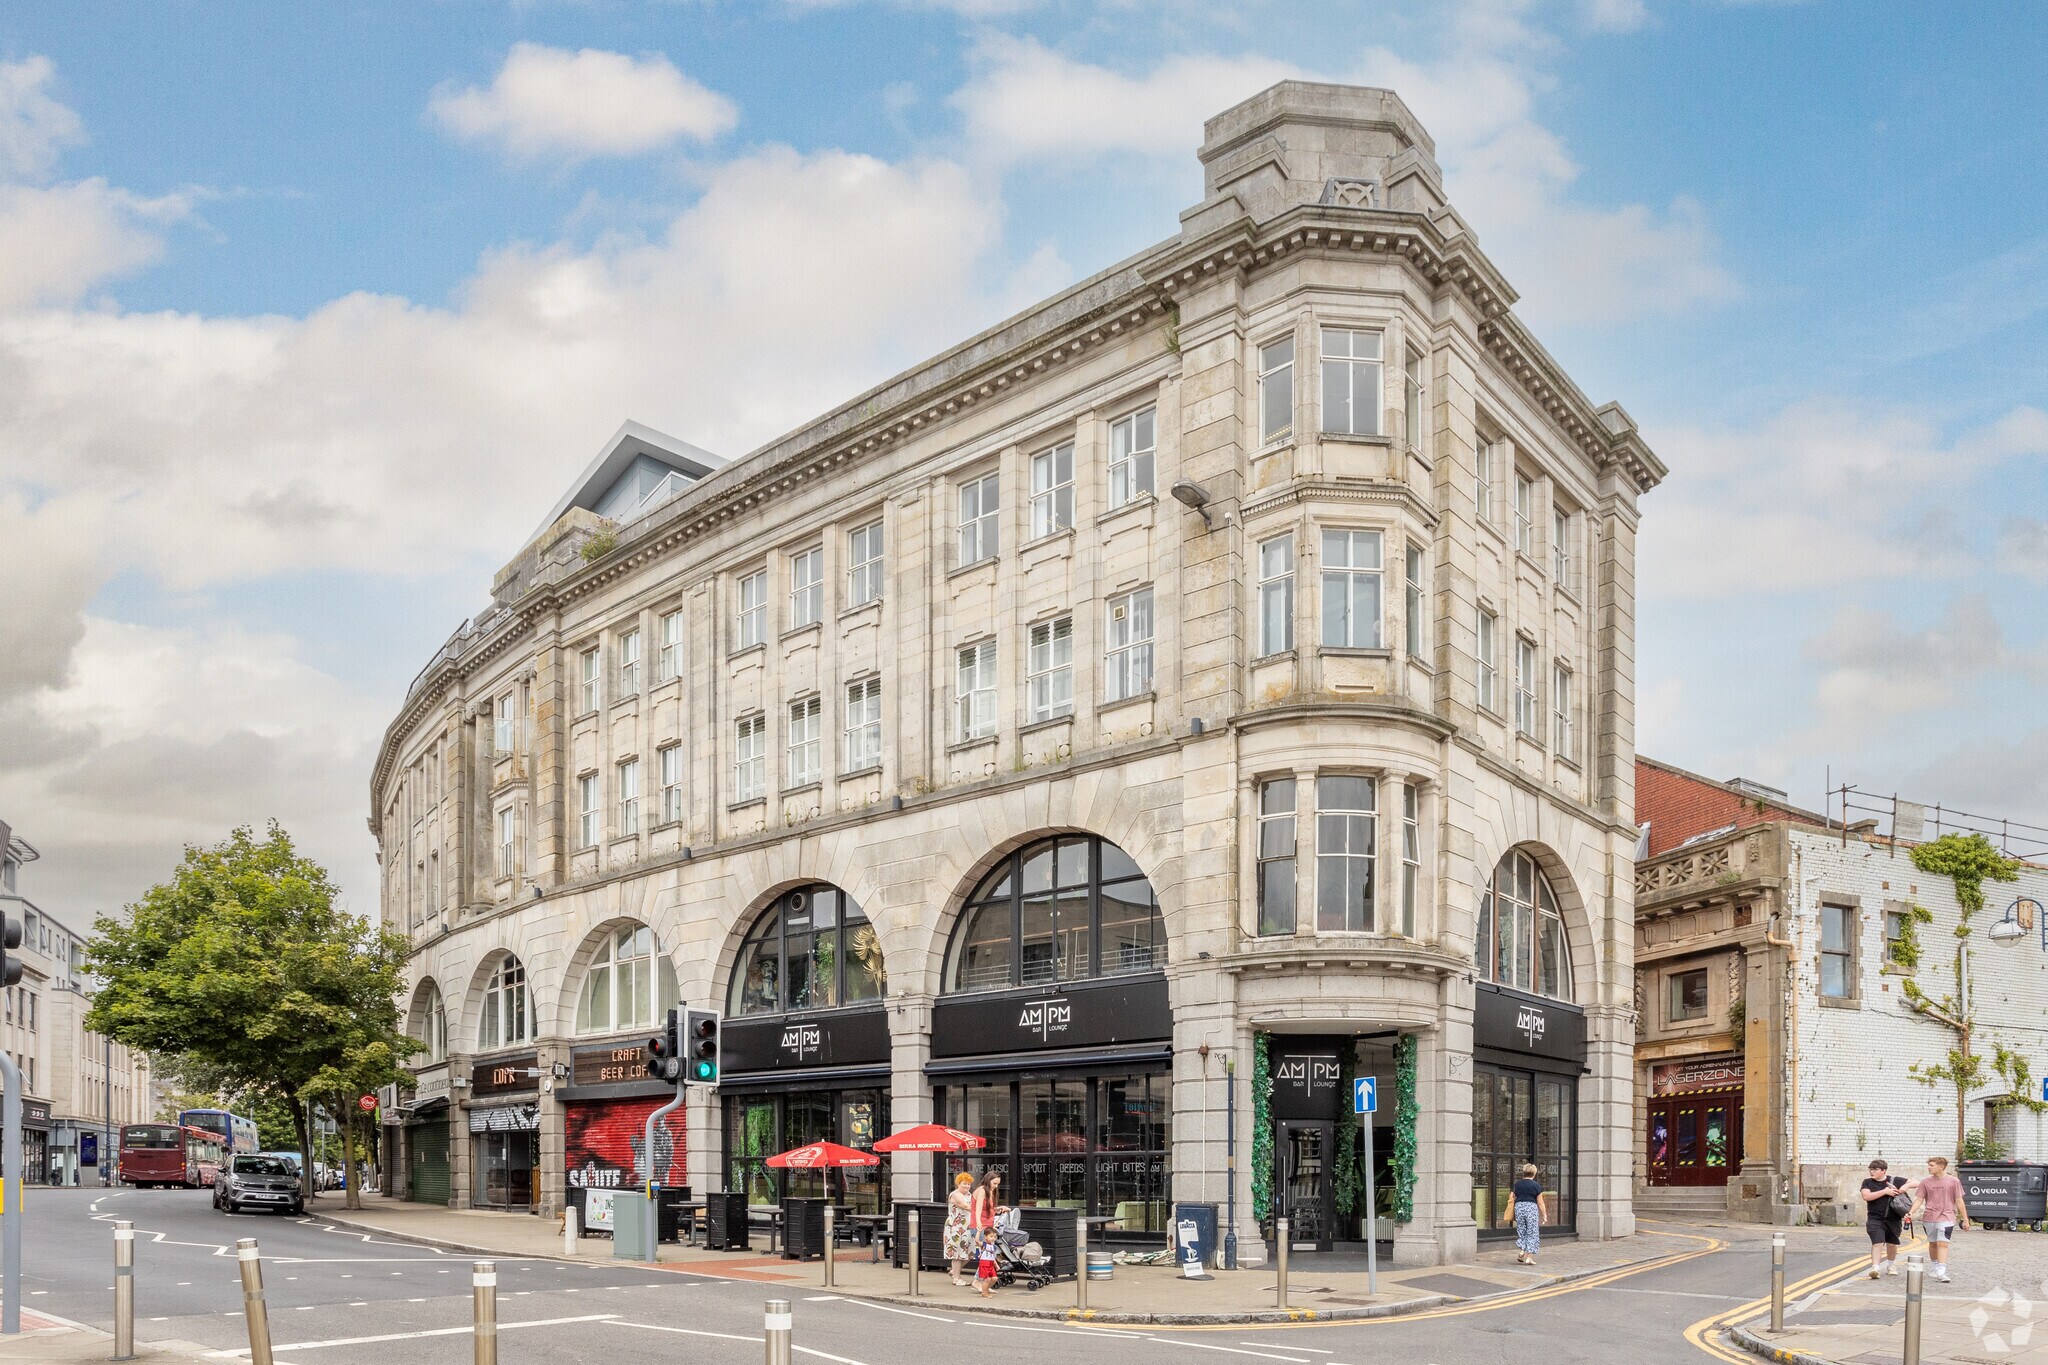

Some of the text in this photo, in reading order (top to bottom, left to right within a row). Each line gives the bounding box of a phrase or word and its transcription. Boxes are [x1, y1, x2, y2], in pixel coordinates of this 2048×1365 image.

[611, 1048, 642, 1062] CRAFT
[1699, 1061, 1731, 1069] ADRENALINE
[601, 1066, 624, 1080] BEER
[1657, 1066, 1745, 1085] LASERZONE
